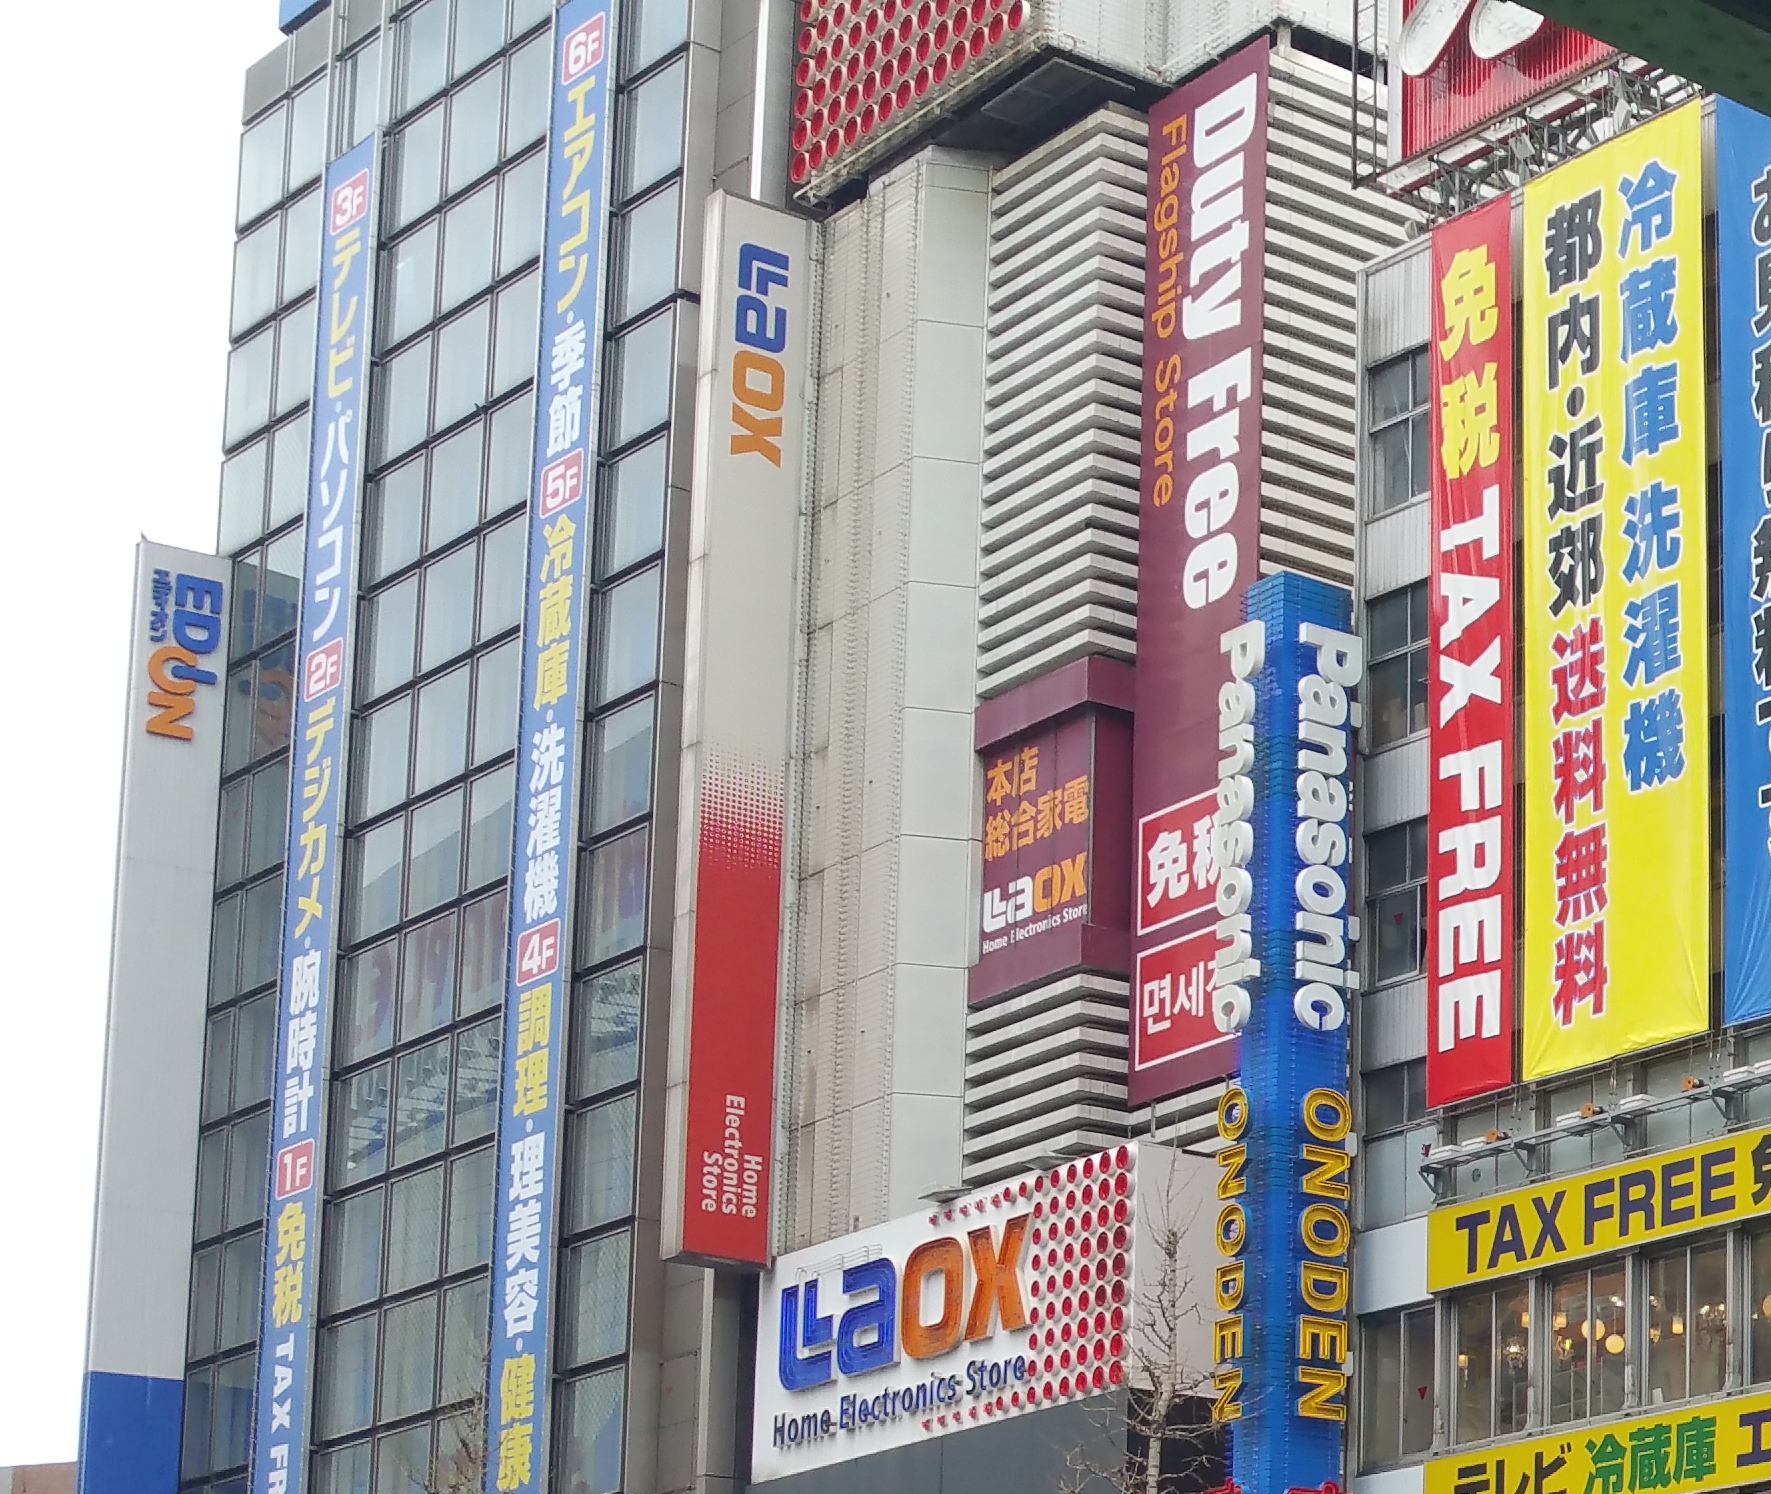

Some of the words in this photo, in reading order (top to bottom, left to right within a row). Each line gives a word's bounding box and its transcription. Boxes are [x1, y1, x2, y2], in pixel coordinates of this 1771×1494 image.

[567, 23, 604, 80] 6F
[333, 176, 368, 228] 3F
[545, 76, 599, 451] エアコン・季節
[1152, 113, 1188, 341] Flagship
[1183, 70, 1259, 342] Duty
[312, 228, 361, 643] テレビ・パソコン
[1152, 354, 1182, 508] Store
[1439, 242, 1500, 482] 免税
[546, 460, 581, 511] 5F
[1183, 345, 1253, 611] Free
[1618, 160, 1688, 794] 冷蔵庫洗濯機
[309, 652, 338, 698] 2F
[1439, 485, 1503, 729] TAX
[523, 517, 577, 925] 冷蔵庫・洗濯機
[986, 746, 1039, 806] 本店
[985, 775, 1090, 862] 総合家電
[1213, 619, 1266, 1034] Panasonic
[1294, 621, 1364, 1033] Panasonic
[1437, 738, 1502, 1053] FREE
[283, 696, 336, 1135] デジカメ・腕時計
[520, 928, 557, 979] 4F
[982, 934, 1009, 955] Home
[1063, 903, 1088, 926] Store
[279, 1148, 311, 1194] 1F
[701, 1149, 718, 1214] Store
[723, 1094, 746, 1217] Electronics
[741, 1154, 764, 1220] Home
[1455, 1190, 1567, 1274] TAX
[1582, 1149, 1738, 1248] FREE
[272, 1202, 307, 1327] 免税
[497, 983, 553, 1491] 調理・理美容・健康
[1214, 1086, 1252, 1423] ONODEN
[1296, 1086, 1354, 1424] ONODEN
[270, 1333, 297, 1433] TAX
[772, 1406, 838, 1450] Home
[838, 1375, 962, 1435] Electronics
[965, 1351, 1028, 1398] Store
